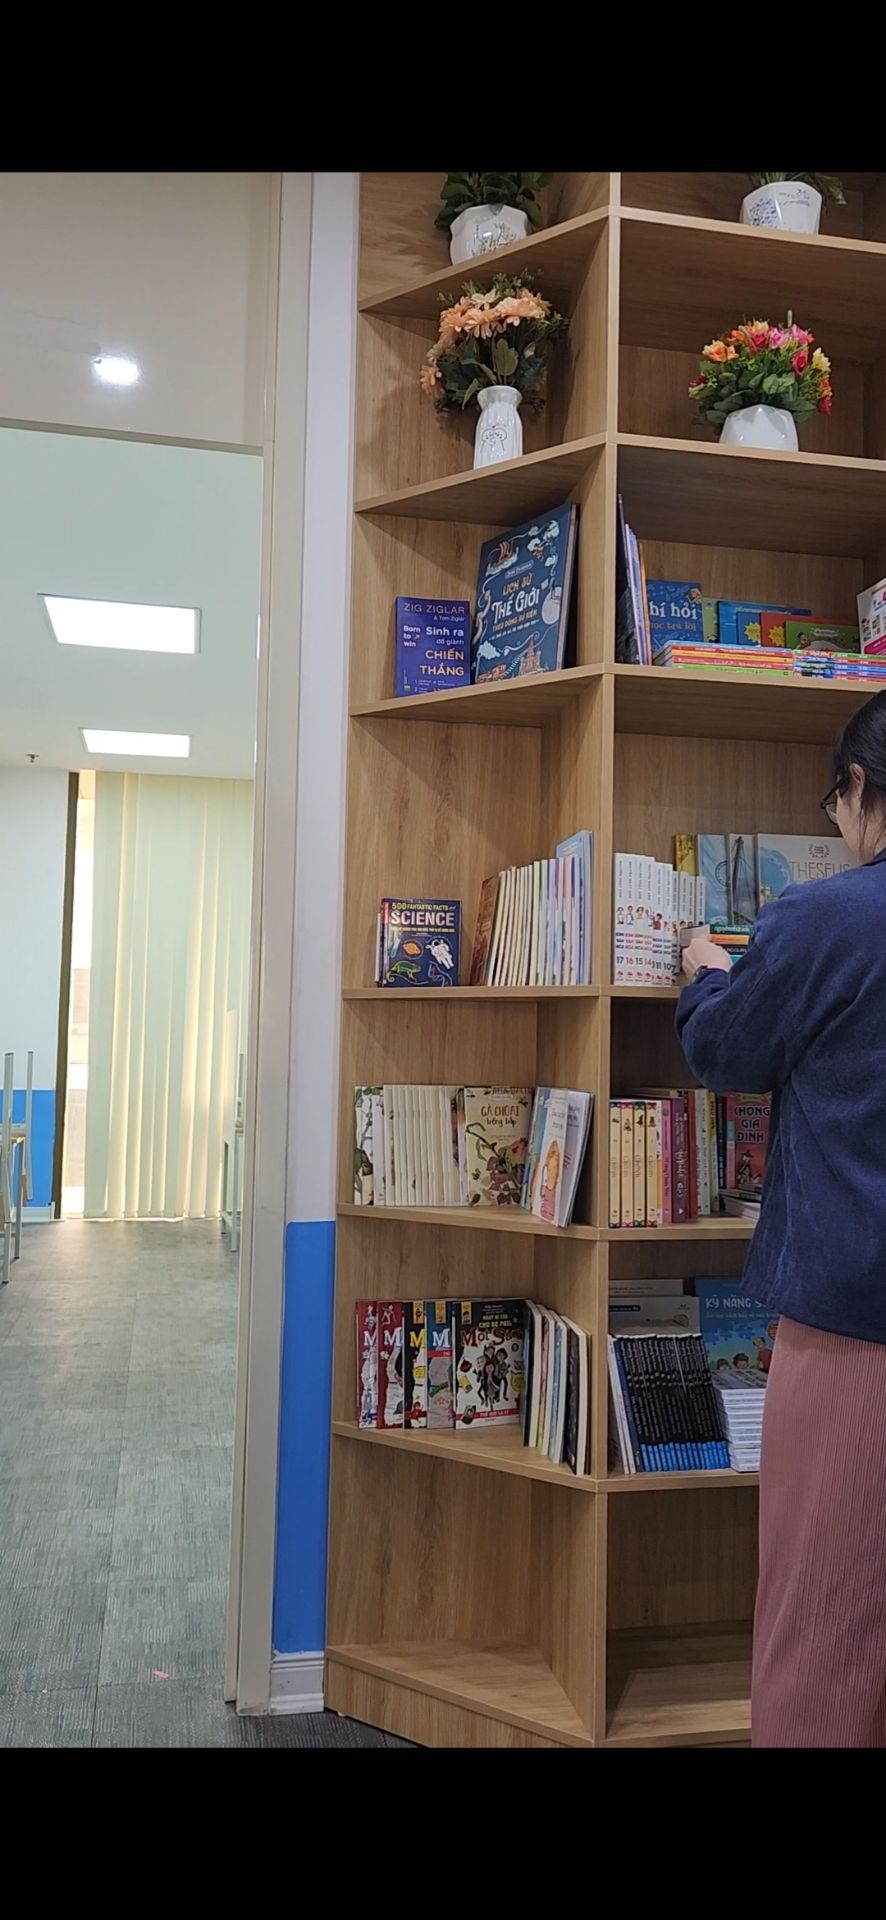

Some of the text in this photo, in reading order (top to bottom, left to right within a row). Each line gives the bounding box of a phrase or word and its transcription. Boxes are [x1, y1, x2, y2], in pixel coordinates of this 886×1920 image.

[404, 603, 464, 614] ZIG ZIGLAR
[670, 602, 698, 620] hỏi
[426, 627, 464, 636] Sinh ra
[425, 648, 464, 660] CHIẾN
[419, 662, 464, 676] THẮNG
[392, 902, 407, 910] 500
[391, 910, 455, 926] SCIENCE
[616, 956, 624, 964] 17
[626, 957, 634, 965] 16
[635, 957, 644, 965] 15
[741, 1119, 760, 1129] GIA
[722, 1294, 752, 1309] NĂNG
